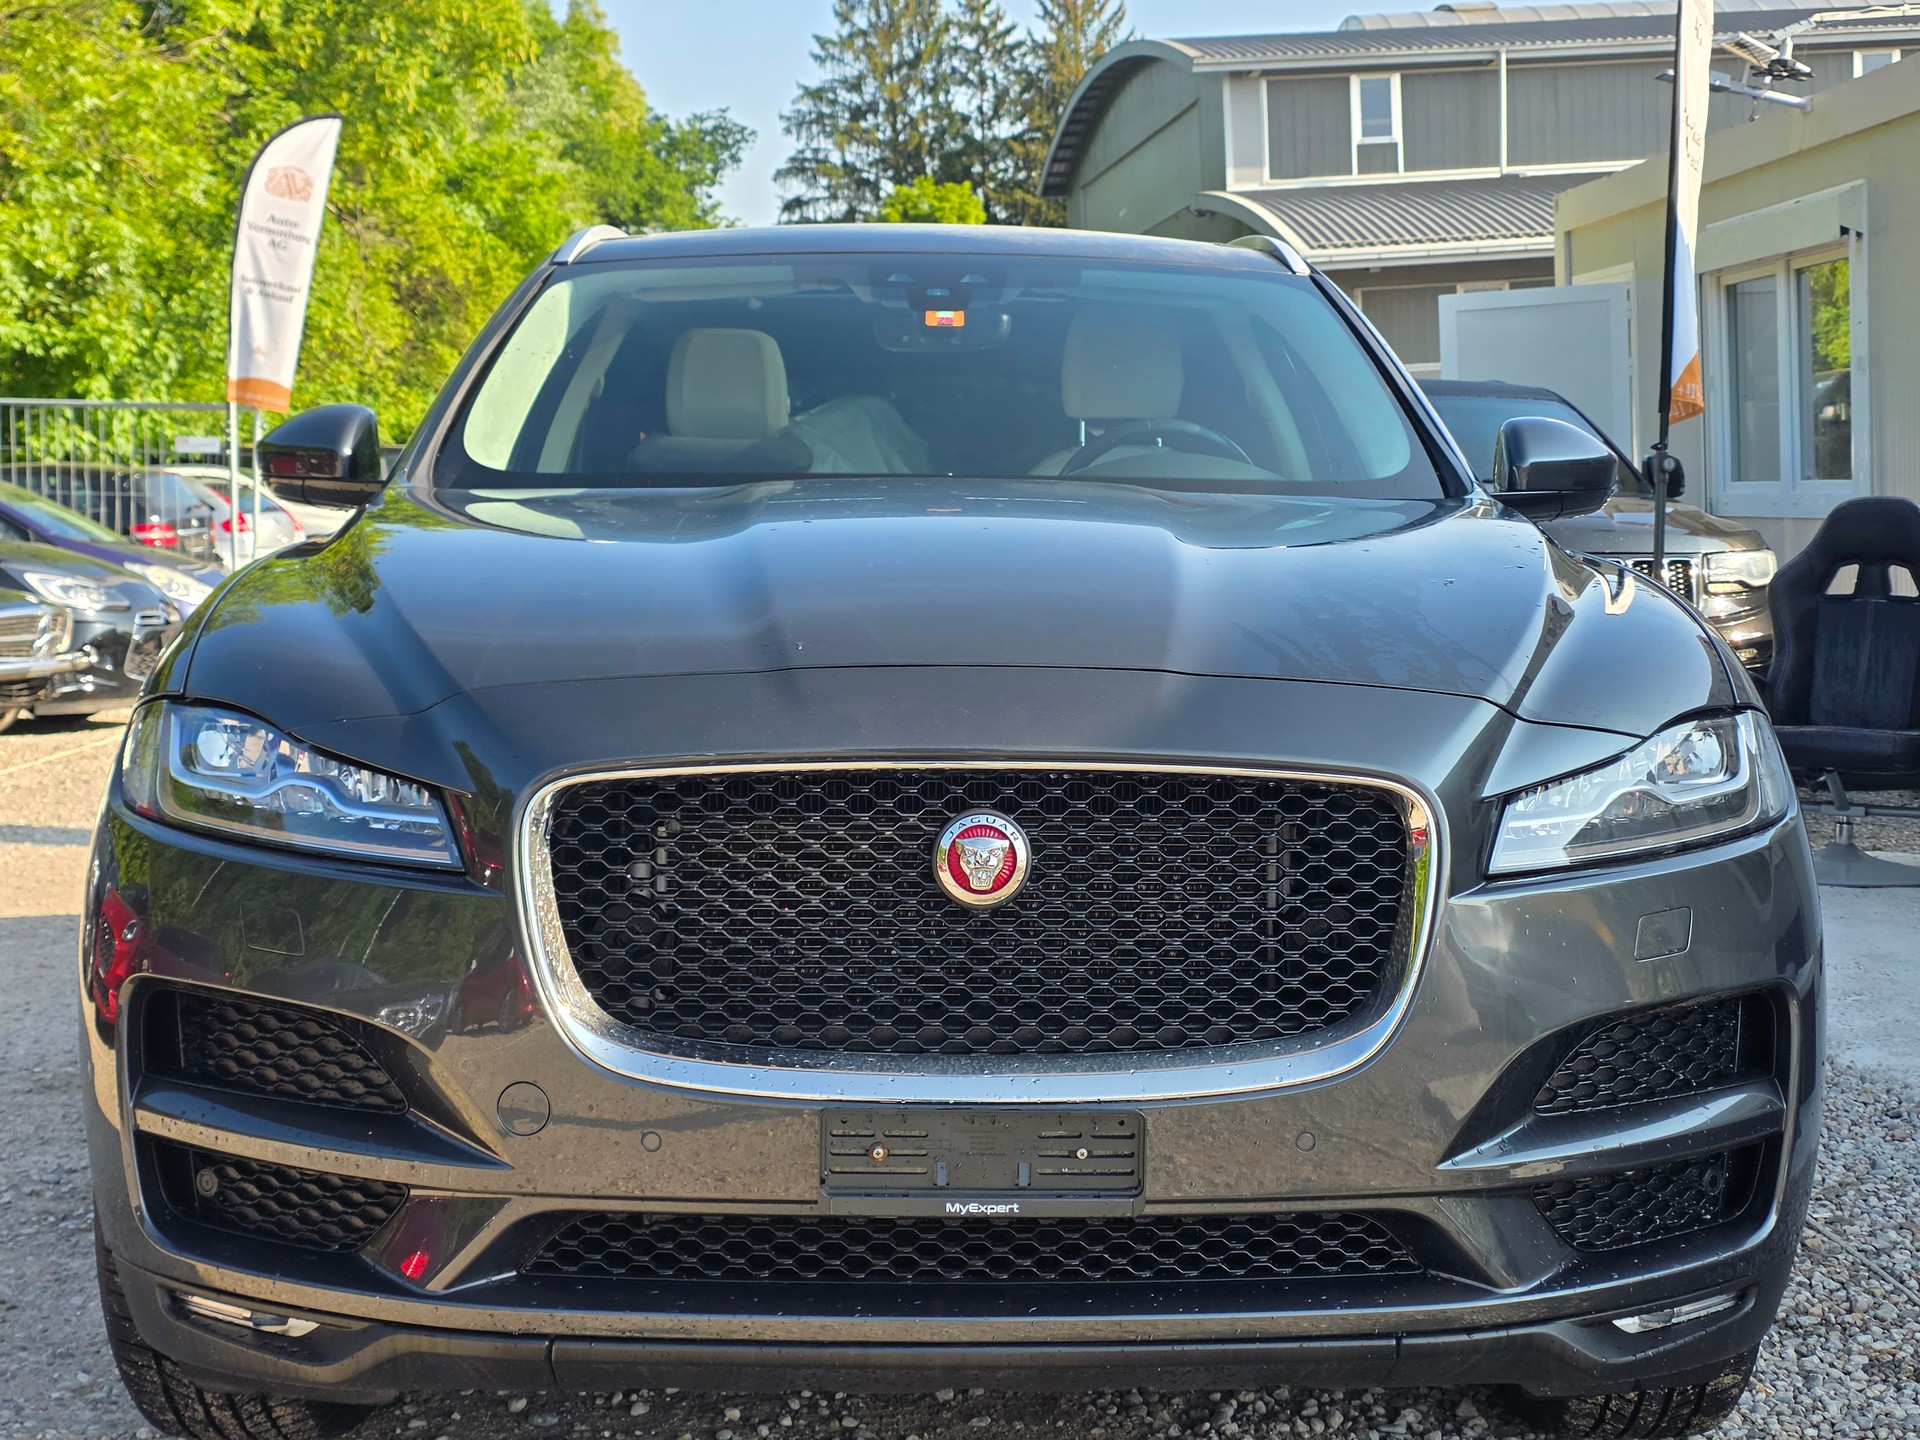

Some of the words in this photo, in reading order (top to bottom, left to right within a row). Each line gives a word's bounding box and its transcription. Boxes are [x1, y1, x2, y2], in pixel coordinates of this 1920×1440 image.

[267, 238, 288, 251] AG
[948, 816, 1020, 841] JAGUAR
[945, 1202, 1020, 1216] MyExpert
